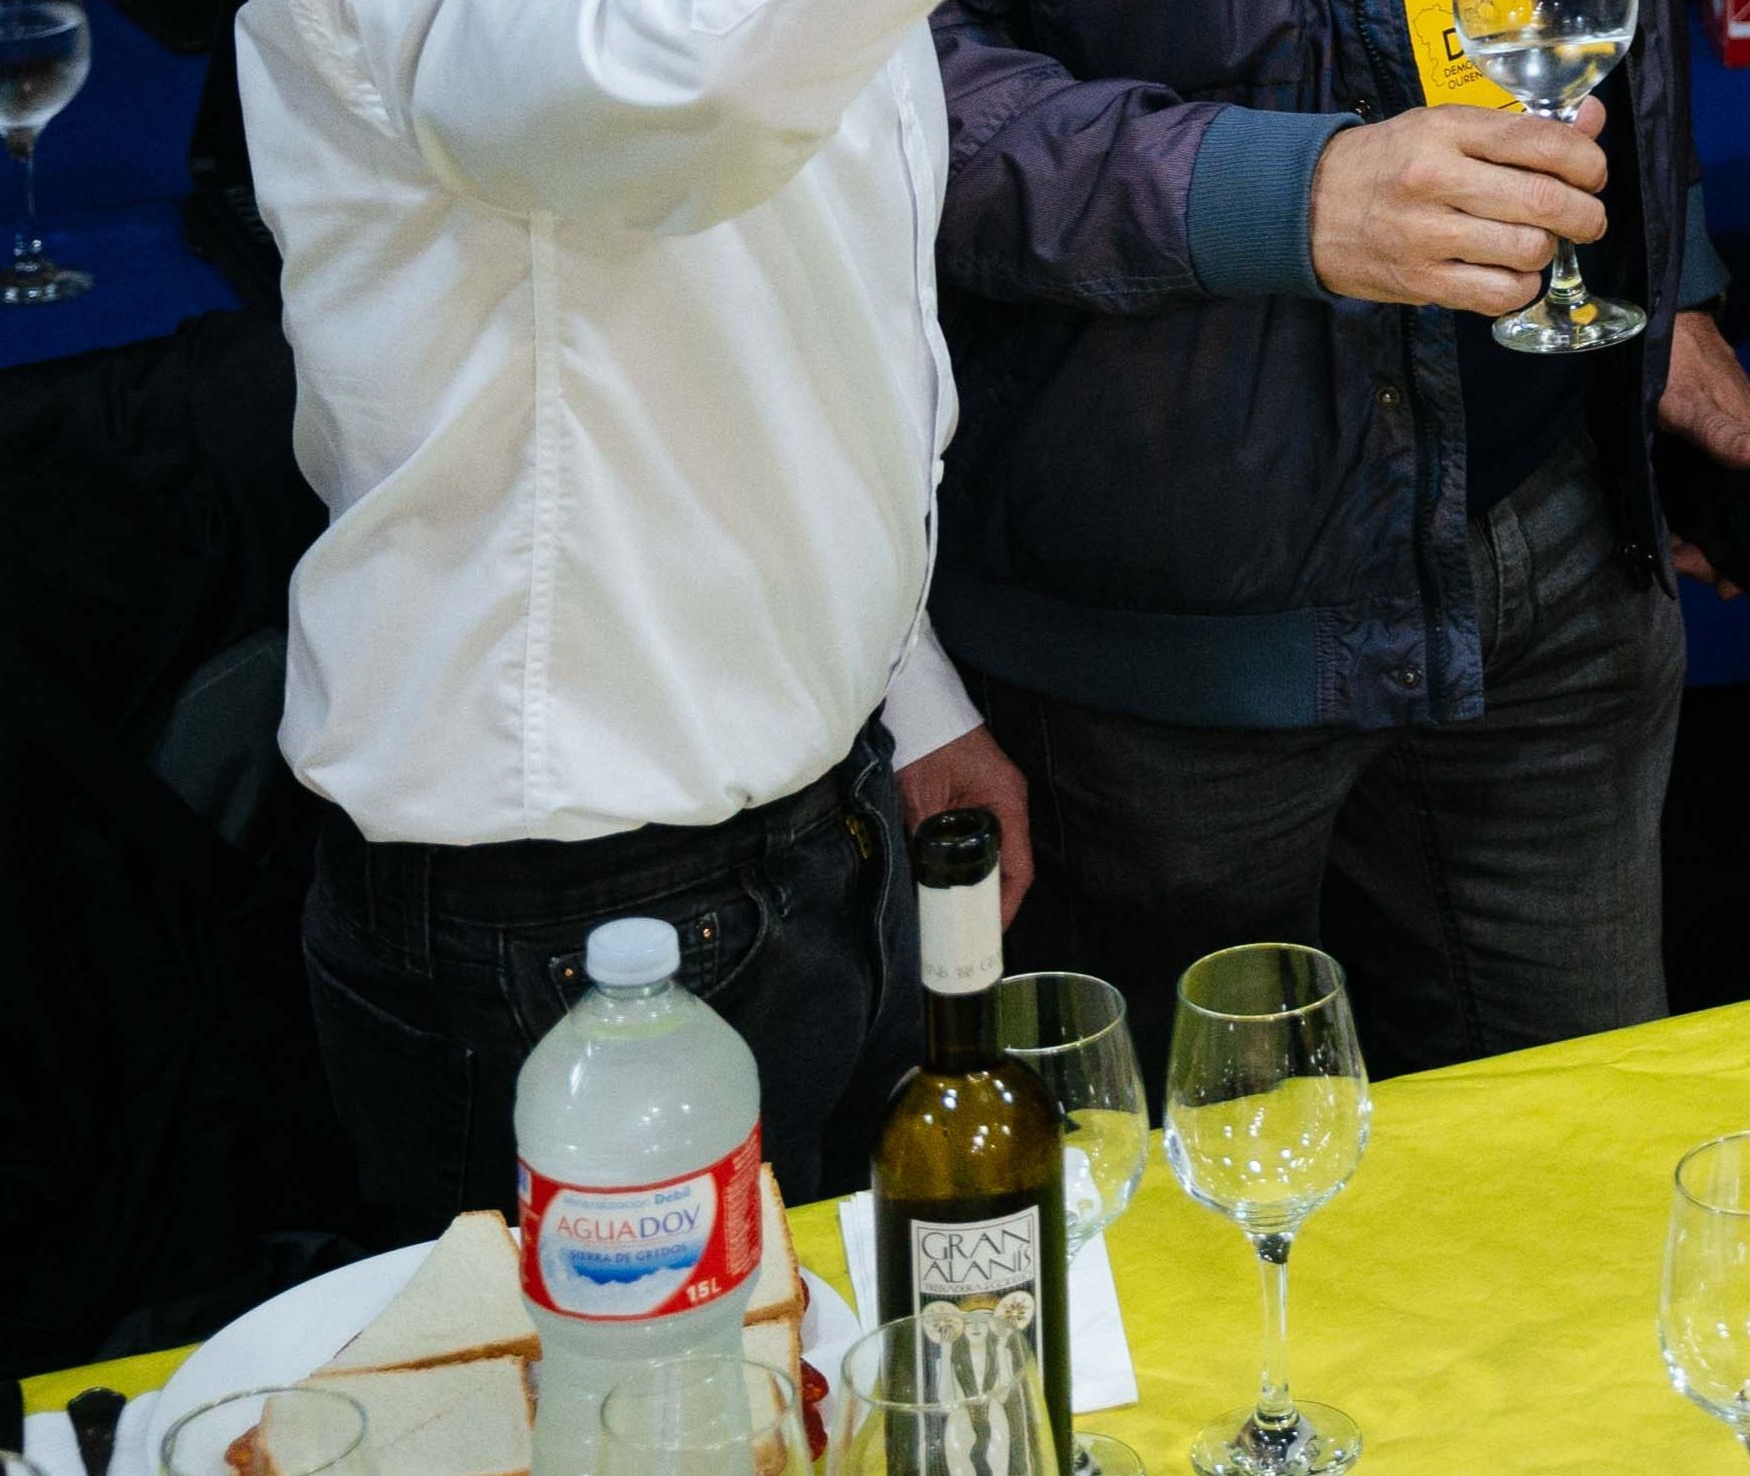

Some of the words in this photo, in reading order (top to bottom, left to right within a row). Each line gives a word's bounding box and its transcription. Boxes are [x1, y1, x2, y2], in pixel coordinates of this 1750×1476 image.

[1442, 27, 1464, 61] D
[1448, 71, 1484, 90] OUREN
[556, 1203, 701, 1241] AGUADOY
[921, 1219, 1031, 1260] GRAN
[568, 1249, 612, 1262] SIERRA
[615, 1252, 629, 1263] DE
[636, 1244, 688, 1261] GREDOS
[923, 1244, 1031, 1283] ALANÍS
